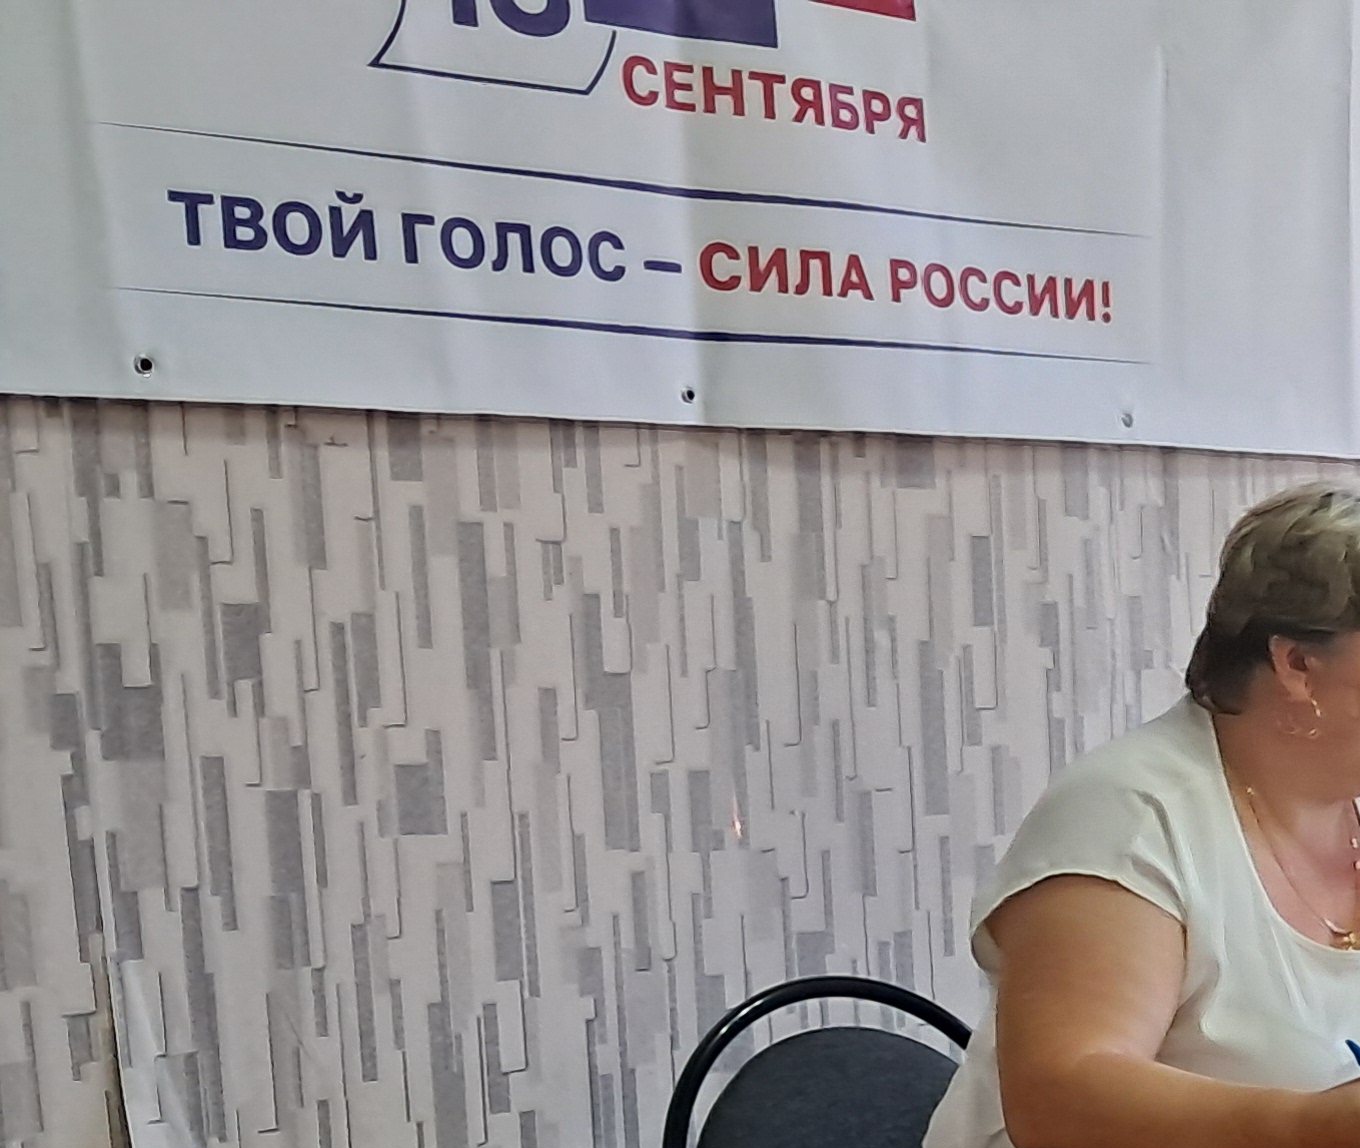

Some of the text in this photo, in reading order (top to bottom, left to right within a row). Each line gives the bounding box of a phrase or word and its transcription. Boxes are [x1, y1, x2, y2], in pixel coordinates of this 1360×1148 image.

[620, 54, 928, 144] СЕНТЯБРЯ
[167, 188, 380, 262] ТВОЙ
[400, 212, 628, 284] ГОЛОС
[697, 240, 874, 302] СИЛА
[888, 258, 1113, 324] РОССИИ!
